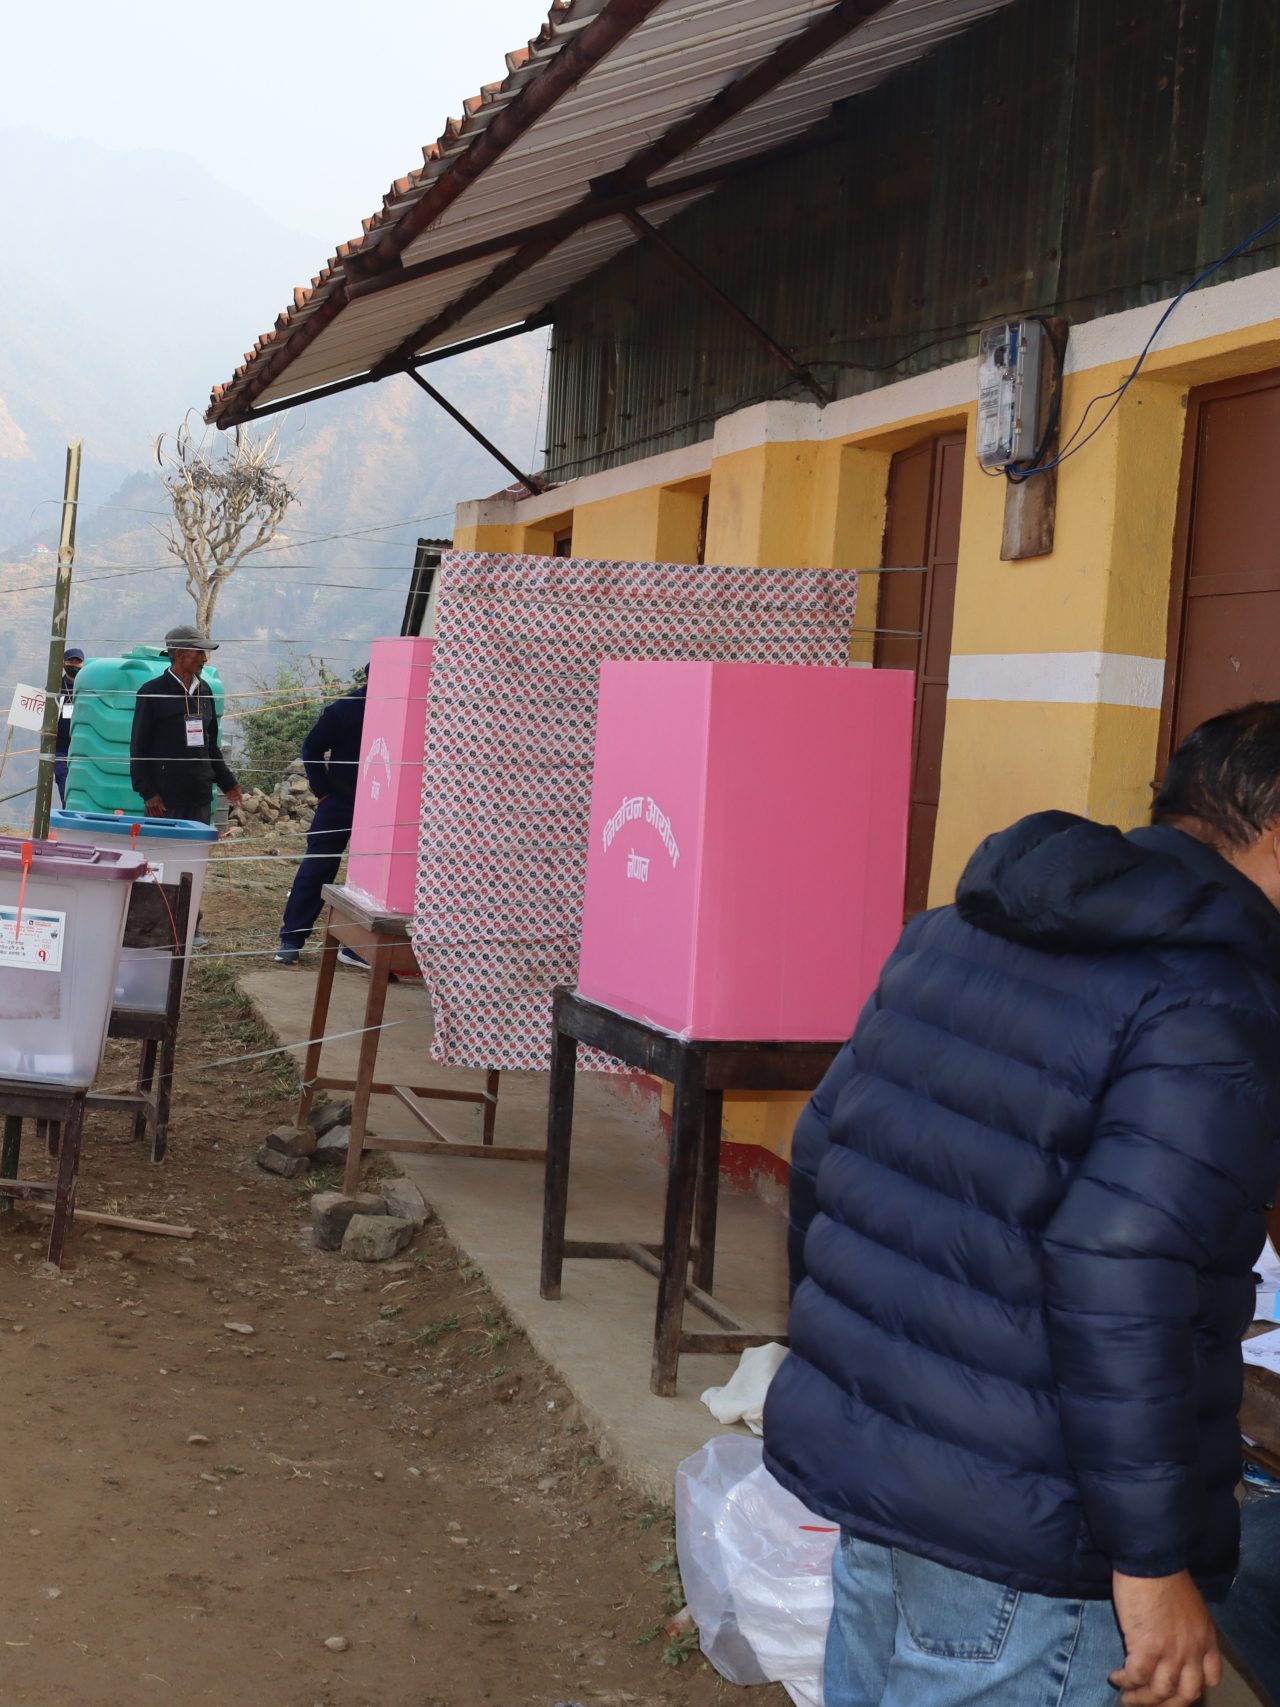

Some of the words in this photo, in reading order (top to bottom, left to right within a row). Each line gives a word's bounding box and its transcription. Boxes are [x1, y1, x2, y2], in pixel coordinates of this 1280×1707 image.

[645, 796, 680, 868] आयोग
[627, 848, 650, 882] नेपाल
[38, 949, 47, 962] १
